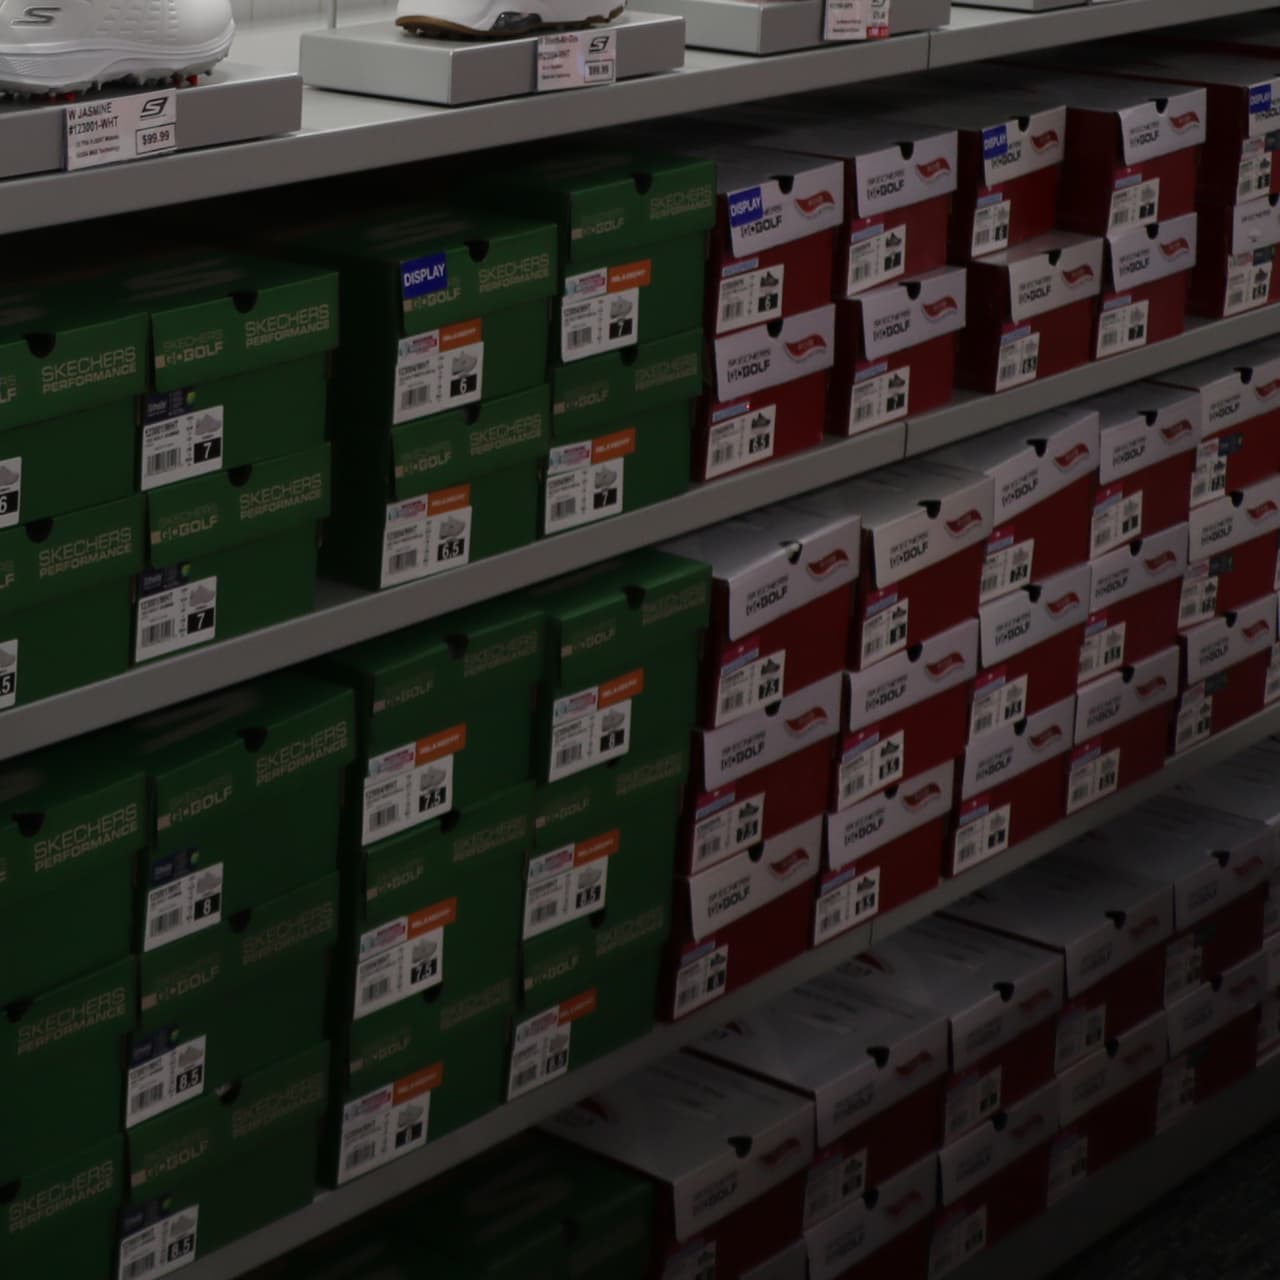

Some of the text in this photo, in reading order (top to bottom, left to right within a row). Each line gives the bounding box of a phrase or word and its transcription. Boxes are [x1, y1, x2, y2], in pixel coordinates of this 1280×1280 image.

[78, 102, 112, 119] JASMINE
[142, 130, 169, 146] $99.99
[730, 197, 762, 217] DISPLAY
[403, 263, 446, 288] DISPLAY
[478, 253, 549, 283] SKECHERS
[245, 304, 329, 337] SKECHERS
[245, 319, 330, 349] PERFORMANCE
[41, 346, 137, 382] SKECHERS
[42, 364, 137, 395] PERFORMANCE
[460, 377, 467, 395] 6
[203, 442, 212, 460] 7
[240, 473, 322, 510] SKECHERS
[240, 489, 322, 520] PERFORMANCE
[38, 528, 132, 566] SKECHERS
[39, 543, 132, 577] PERFORMANCE
[443, 542, 460, 559] 6.5
[196, 612, 206, 630] 7
[256, 721, 347, 774] SKECHERS
[256, 738, 348, 787] PERFORMANCE
[33, 802, 137, 860] SKECHERS
[34, 821, 138, 872] PERFORMANCE
[203, 898, 212, 915] 8
[17, 987, 126, 1040] SKECHERS
[178, 1067, 200, 1092] 8.5
[8, 1160, 114, 1220] SKECHERS
